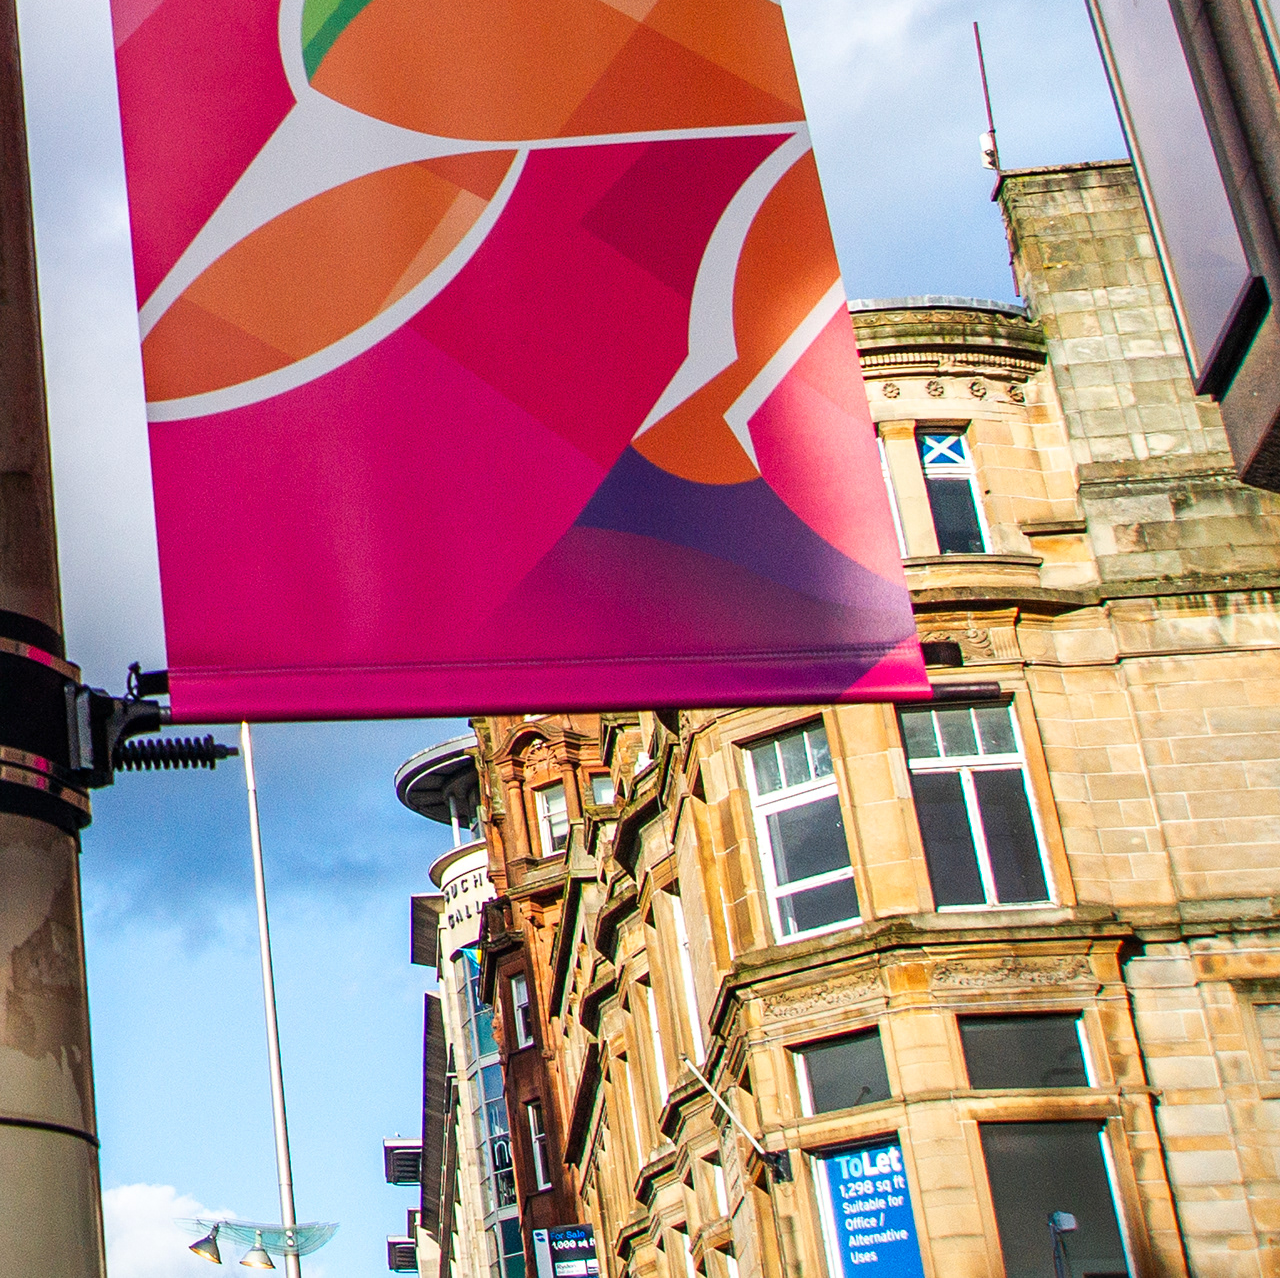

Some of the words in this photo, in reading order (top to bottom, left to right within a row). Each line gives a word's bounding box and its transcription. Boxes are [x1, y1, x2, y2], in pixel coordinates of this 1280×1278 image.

[839, 1180, 875, 1199] 1,298
[875, 1179, 893, 1193] sq
[893, 1174, 906, 1189] ft
[842, 1197, 887, 1215] Suitable
[887, 1195, 904, 1207] for
[845, 1216, 878, 1231] Office
[879, 1212, 885, 1226] /
[550, 1231, 564, 1240] For
[848, 1229, 909, 1247] Alternative
[850, 1251, 878, 1265] Uses
